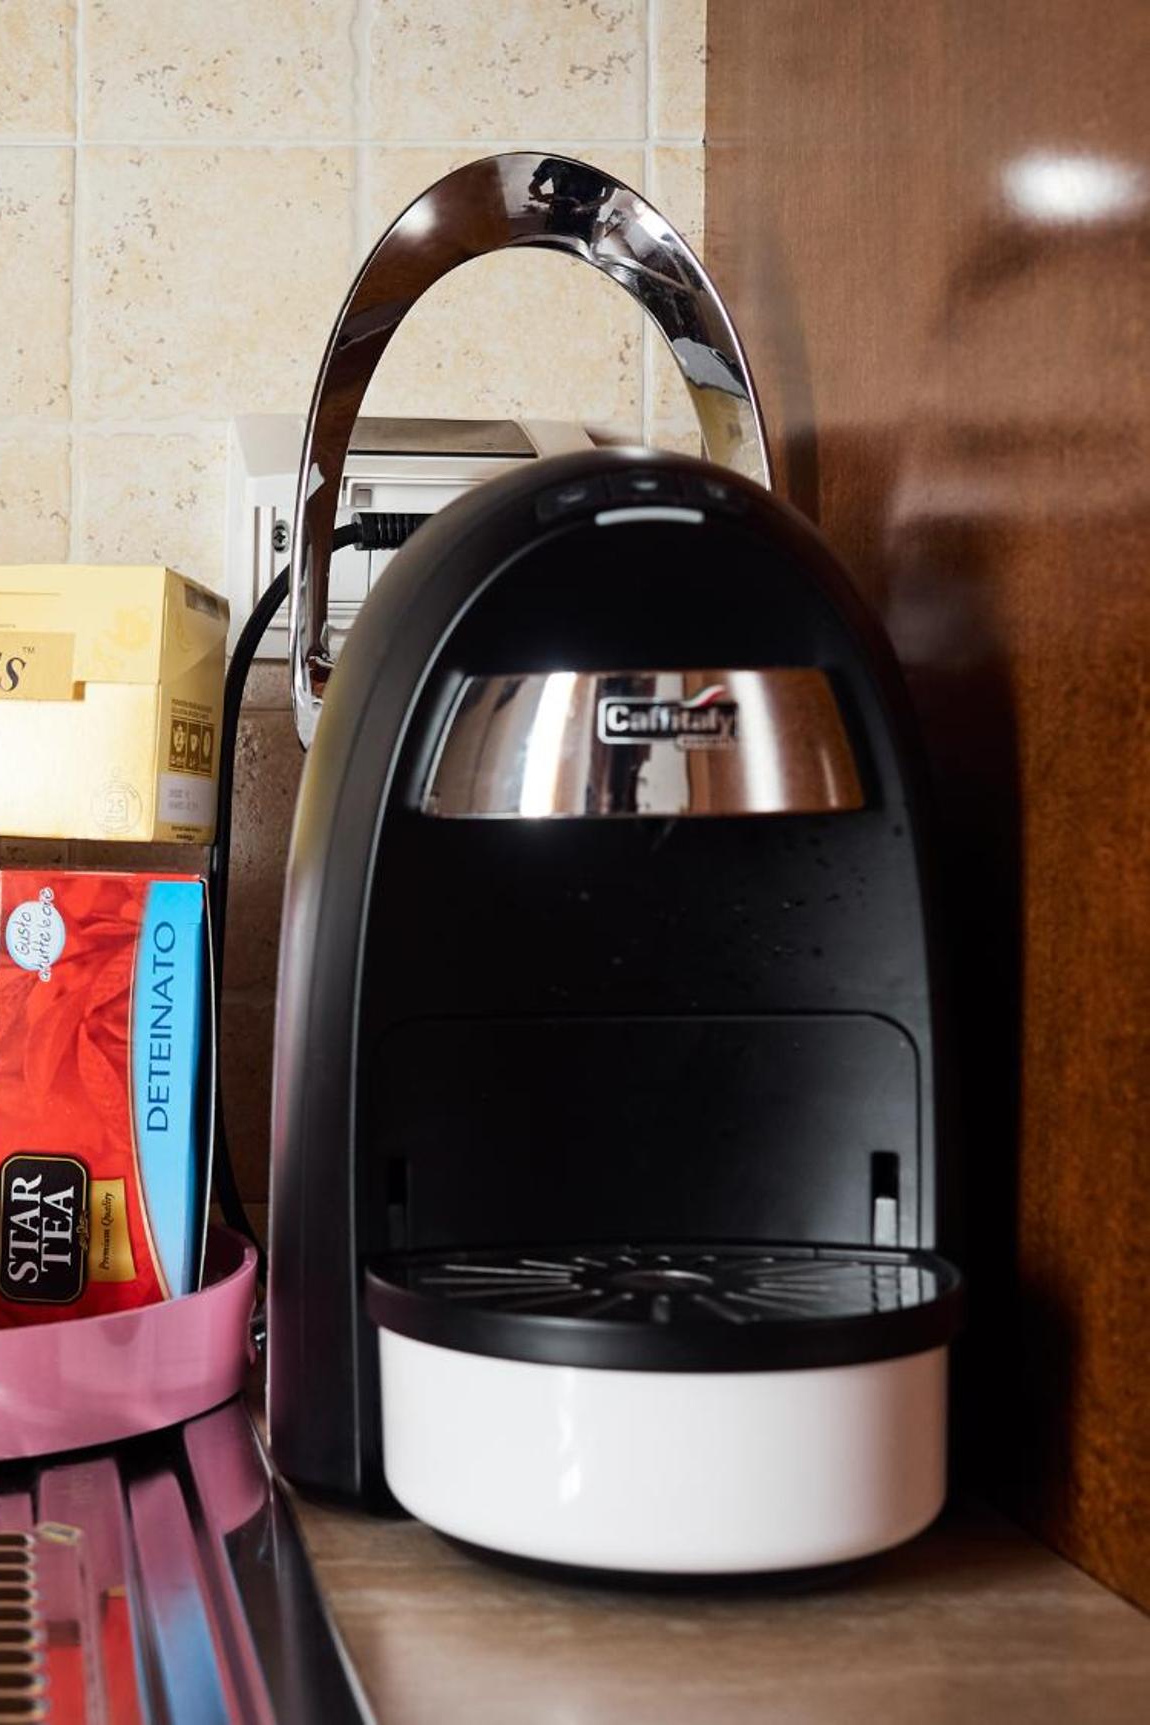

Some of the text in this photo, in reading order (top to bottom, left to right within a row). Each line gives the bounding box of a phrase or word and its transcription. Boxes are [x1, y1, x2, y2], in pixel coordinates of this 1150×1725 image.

[606, 704, 734, 736] Caffitaly
[13, 911, 31, 956] Gusto
[146, 921, 176, 1132] DETEINATO
[8, 1173, 42, 1284] STAR
[41, 1185, 74, 1273] TEA
[99, 1192, 115, 1270] Premium Quality
